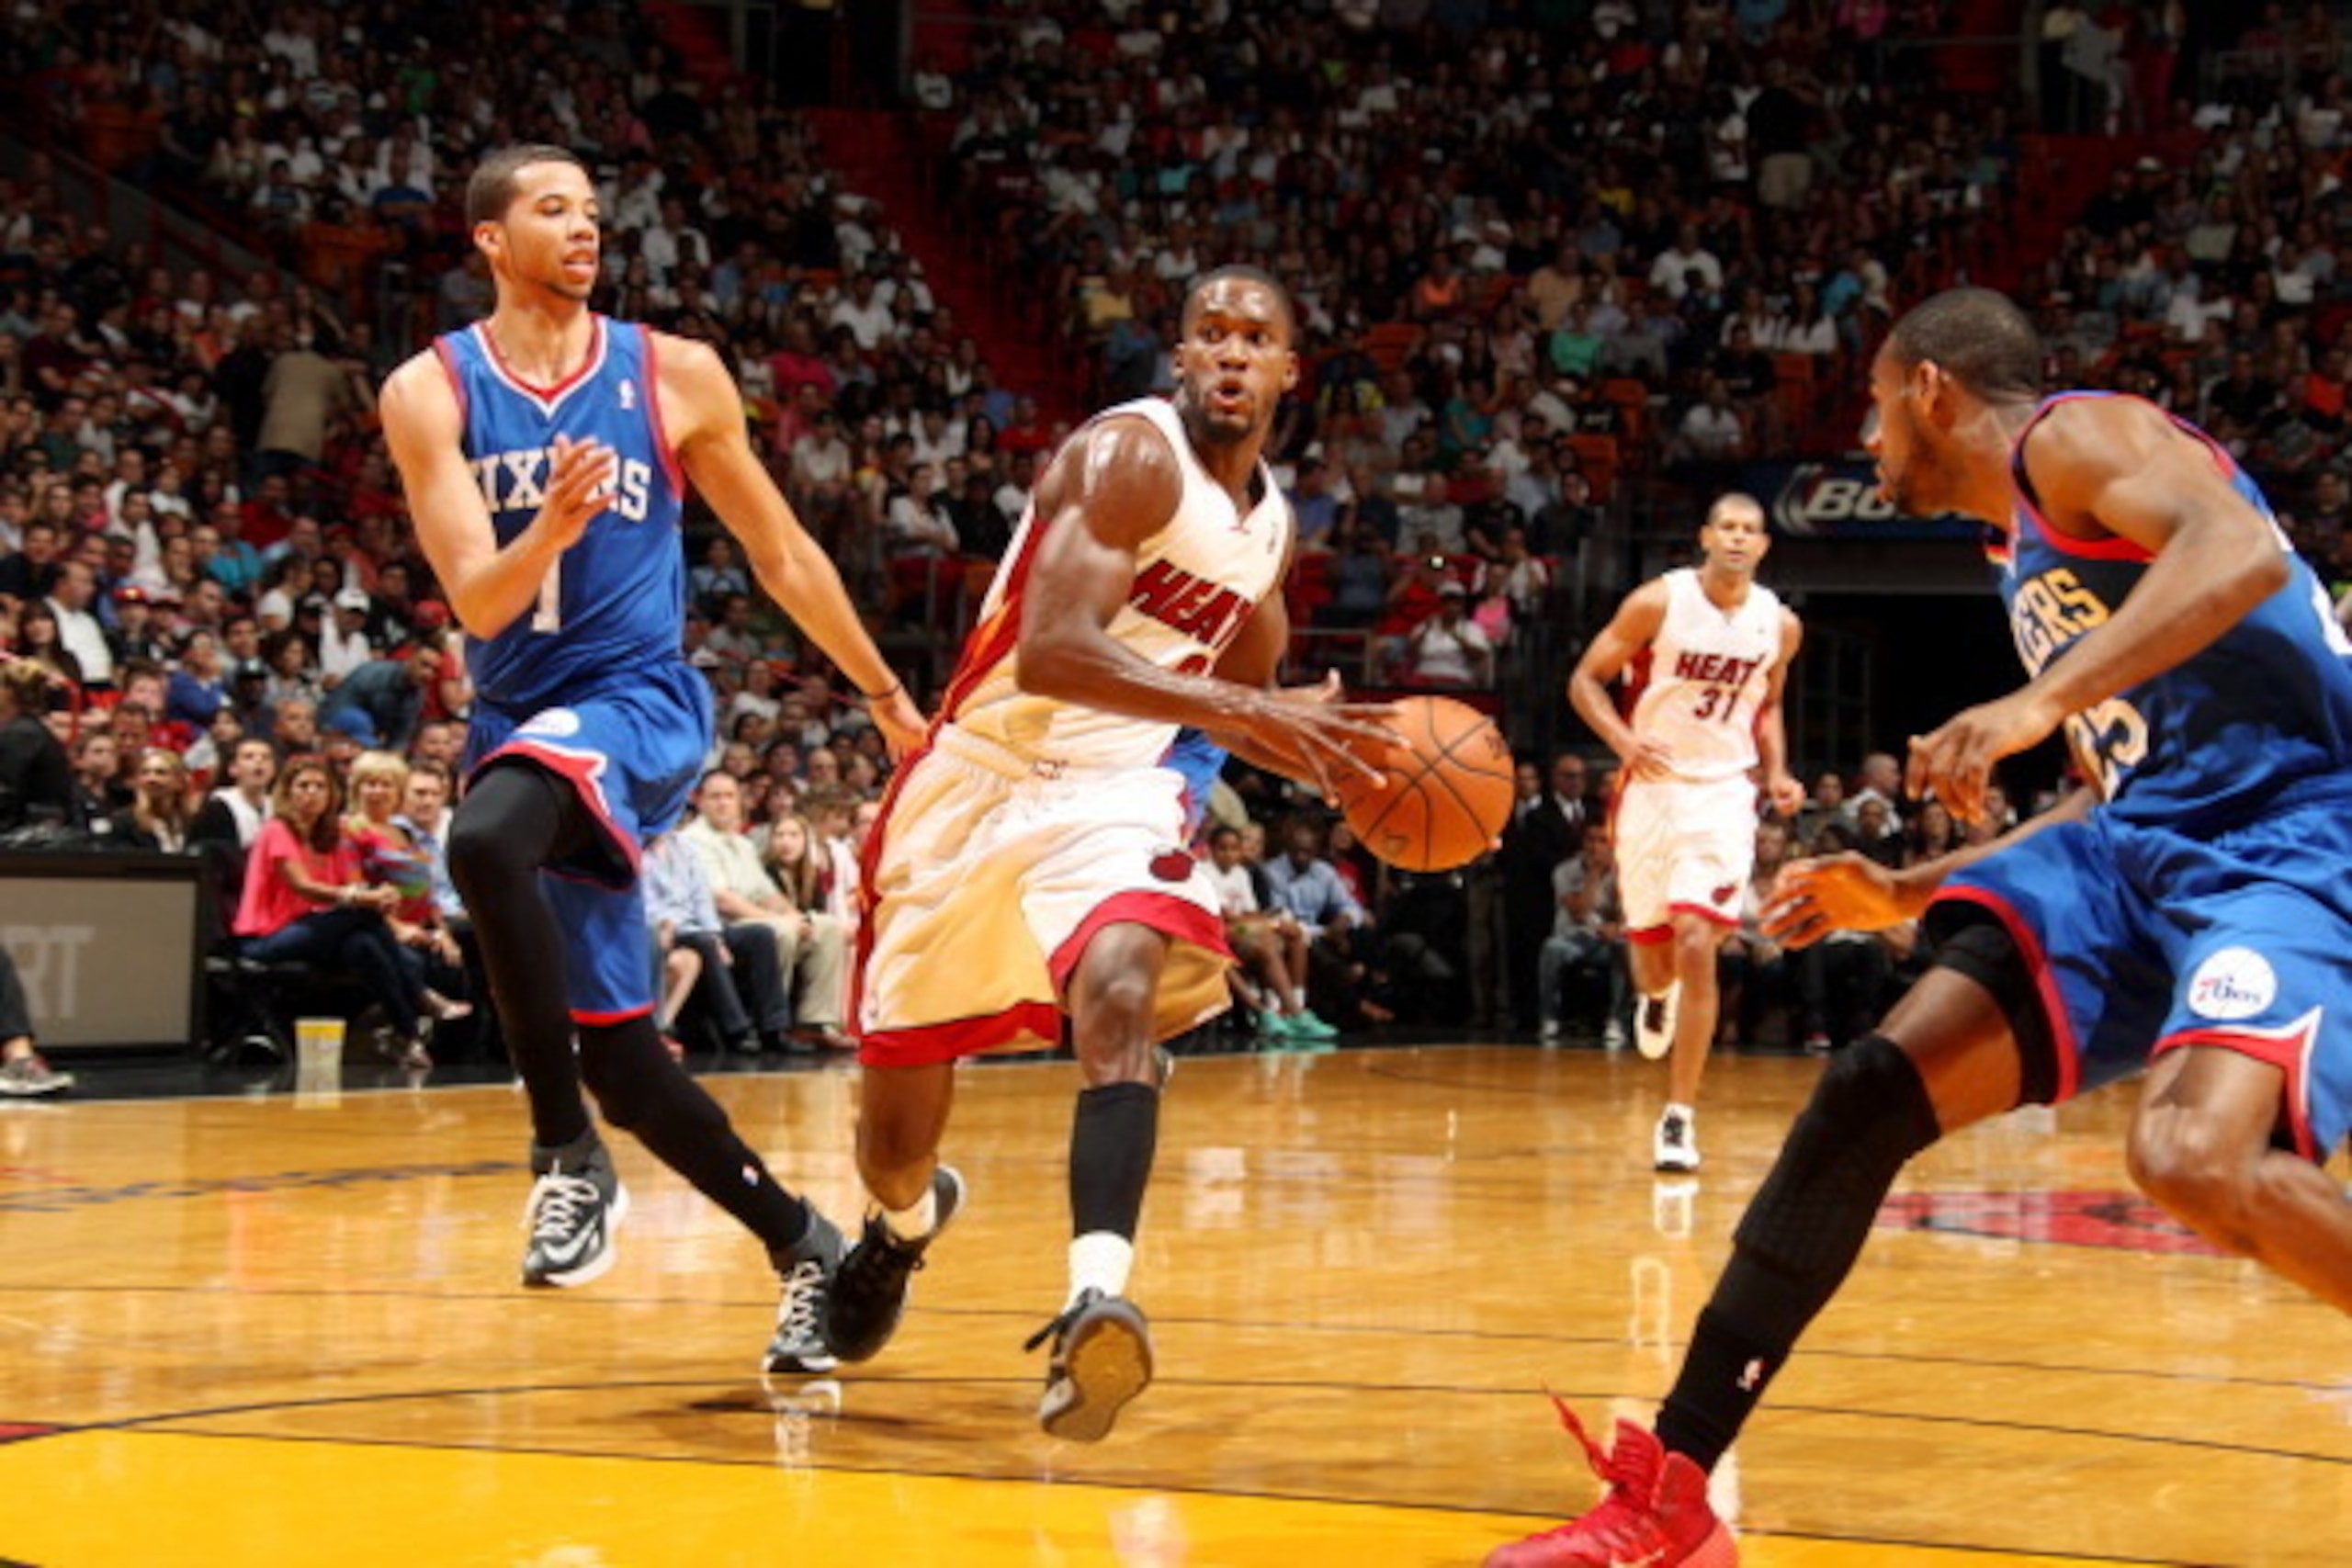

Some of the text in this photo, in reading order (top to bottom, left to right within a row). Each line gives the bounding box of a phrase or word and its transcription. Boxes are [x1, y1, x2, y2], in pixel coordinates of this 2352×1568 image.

[469, 446, 651, 522] IXRS
[2009, 567, 2110, 679] ERS
[1675, 650, 1766, 687] HEAT
[1694, 686, 1739, 725] 31
